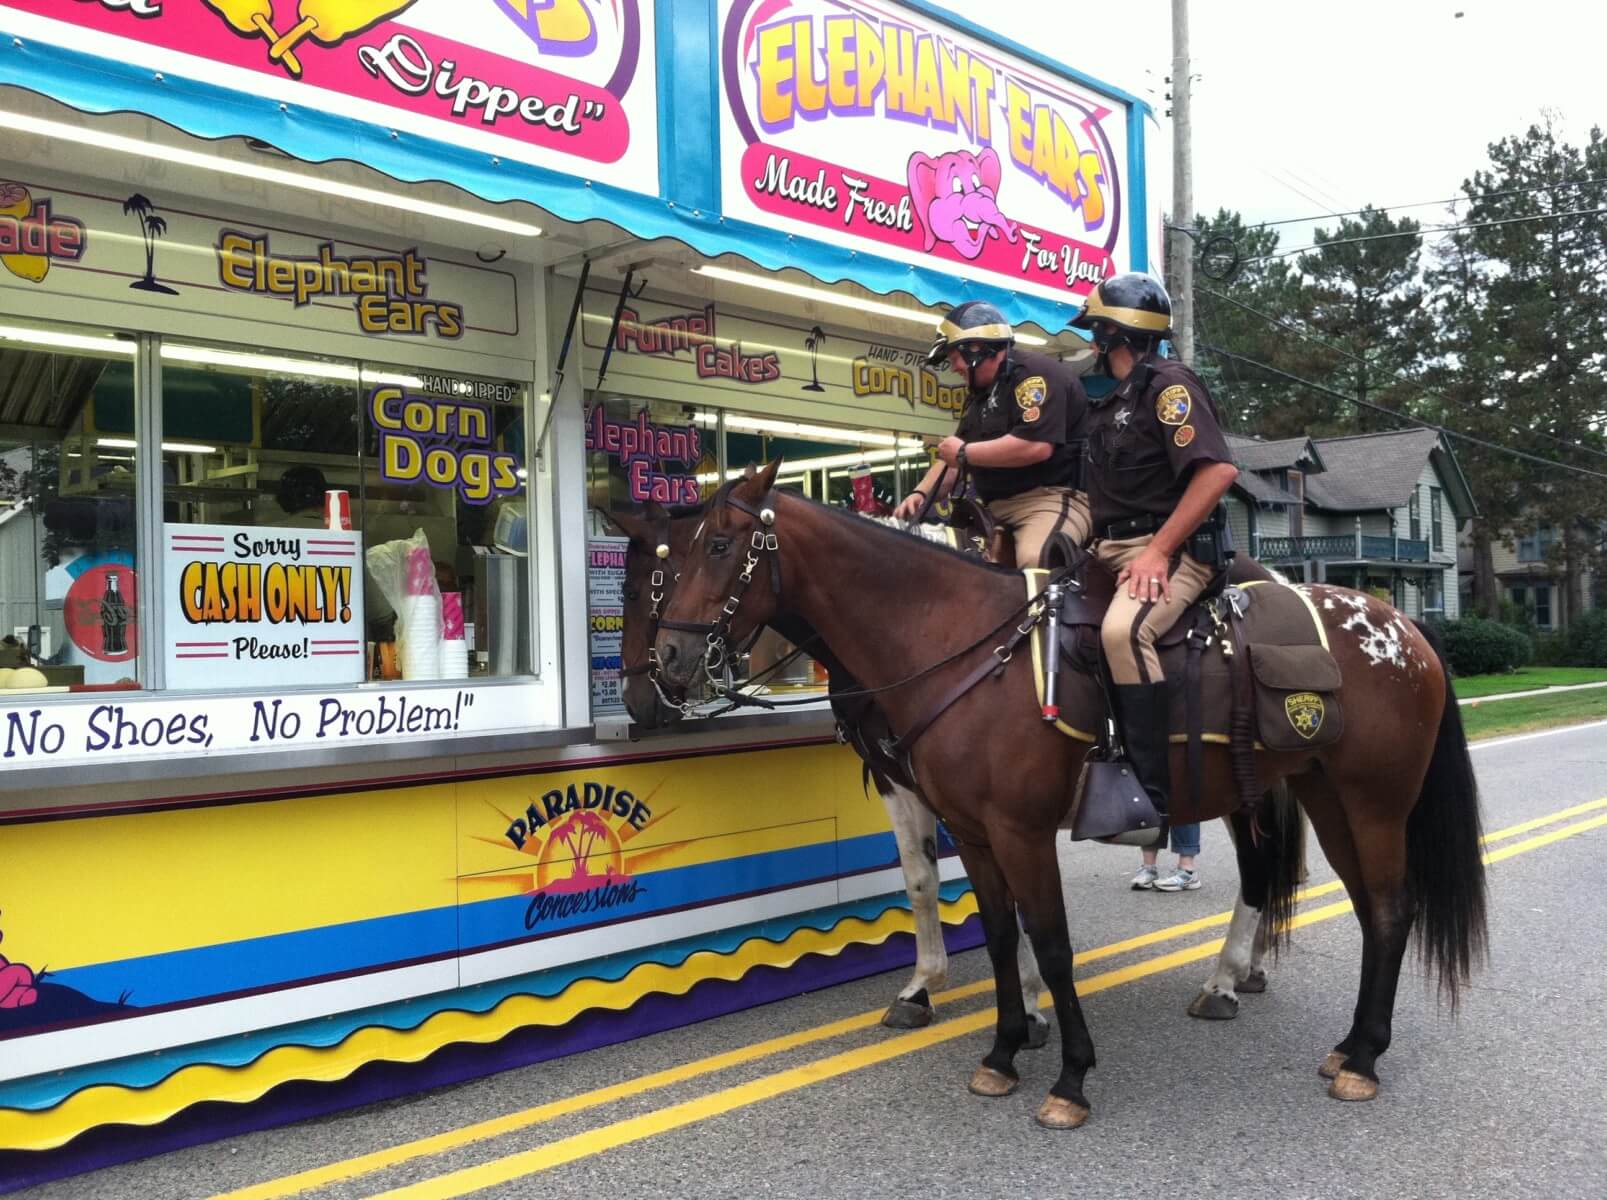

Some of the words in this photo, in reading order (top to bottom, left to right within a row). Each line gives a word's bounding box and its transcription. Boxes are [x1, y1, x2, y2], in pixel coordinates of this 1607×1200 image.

[750, 14, 1000, 146] ELEPHANT
[998, 72, 1106, 232] EARS
[754, 155, 838, 209] Made
[841, 173, 913, 231] Fresh
[214, 228, 429, 308] Elephant
[1020, 228, 1058, 272] For
[1060, 244, 1108, 286] You!
[354, 293, 464, 340] Ears
[616, 302, 716, 356] Funnel
[696, 339, 781, 384] Cakes
[853, 356, 915, 410] Corn
[920, 367, 970, 421] Dog
[370, 386, 490, 444] Corn
[584, 404, 700, 466] lephant
[380, 432, 521, 505] Dogs
[630, 458, 699, 504] Ears
[233, 532, 302, 561] Sorry
[179, 560, 263, 626] CASH
[263, 561, 353, 626] ONLY!
[232, 636, 309, 660] Please!
[3, 709, 65, 758] No
[86, 705, 214, 752] Shoes,
[250, 699, 301, 742] No
[316, 691, 474, 738] Problem!"
[505, 782, 651, 850] PARADISE
[524, 879, 647, 930] Concessions
